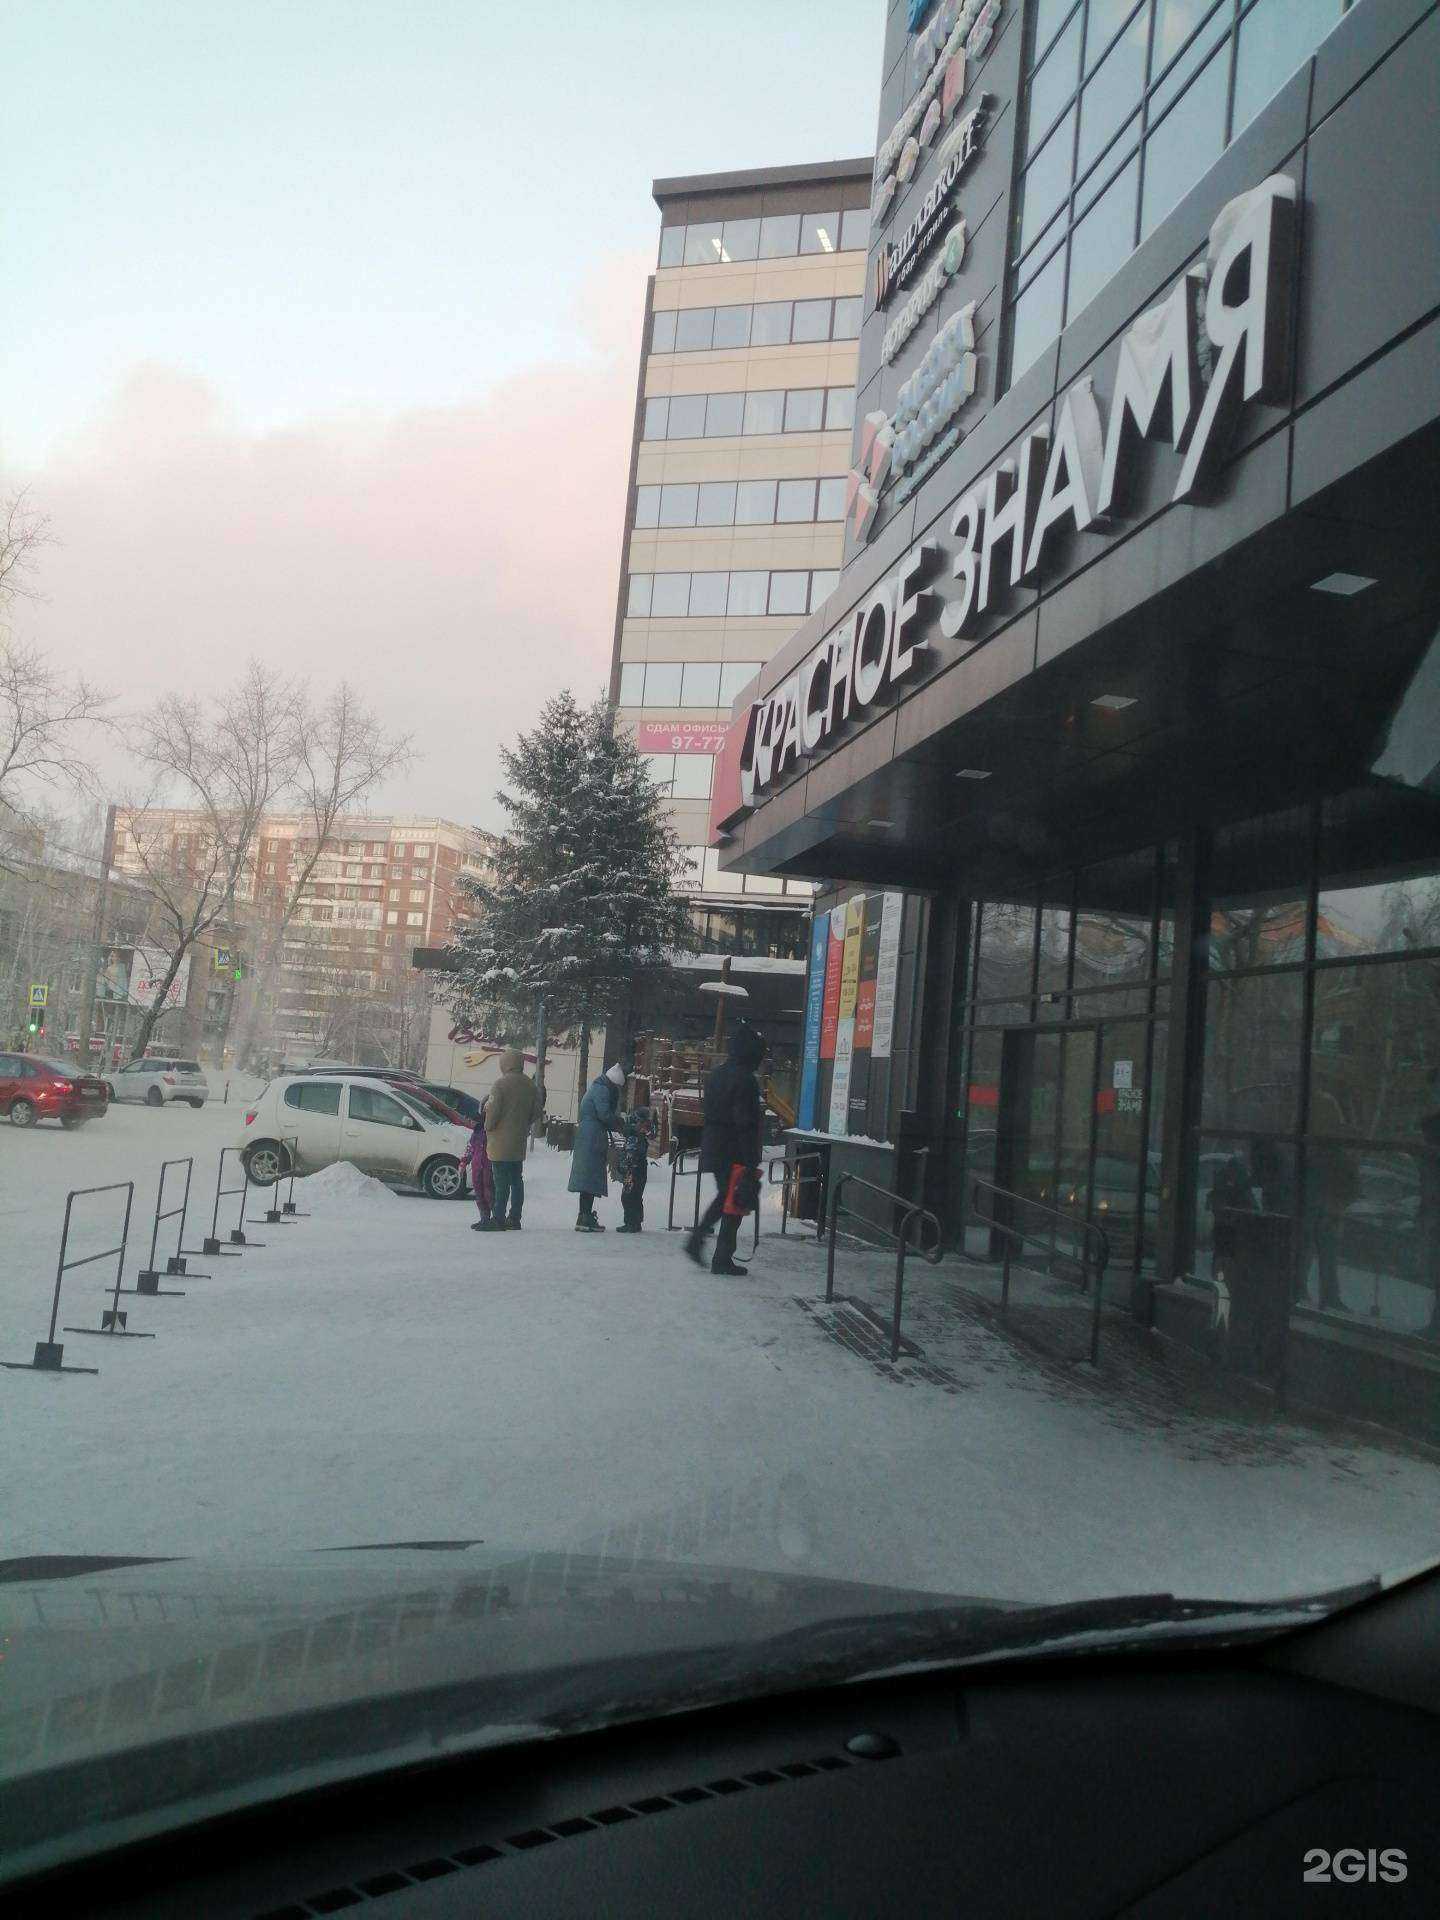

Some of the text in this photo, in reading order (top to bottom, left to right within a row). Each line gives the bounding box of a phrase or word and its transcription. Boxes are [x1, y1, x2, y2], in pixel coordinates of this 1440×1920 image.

[747, 178, 1282, 795] КРАСНОЕ ЗНАМЯ
[646, 723, 680, 734] СДАМ
